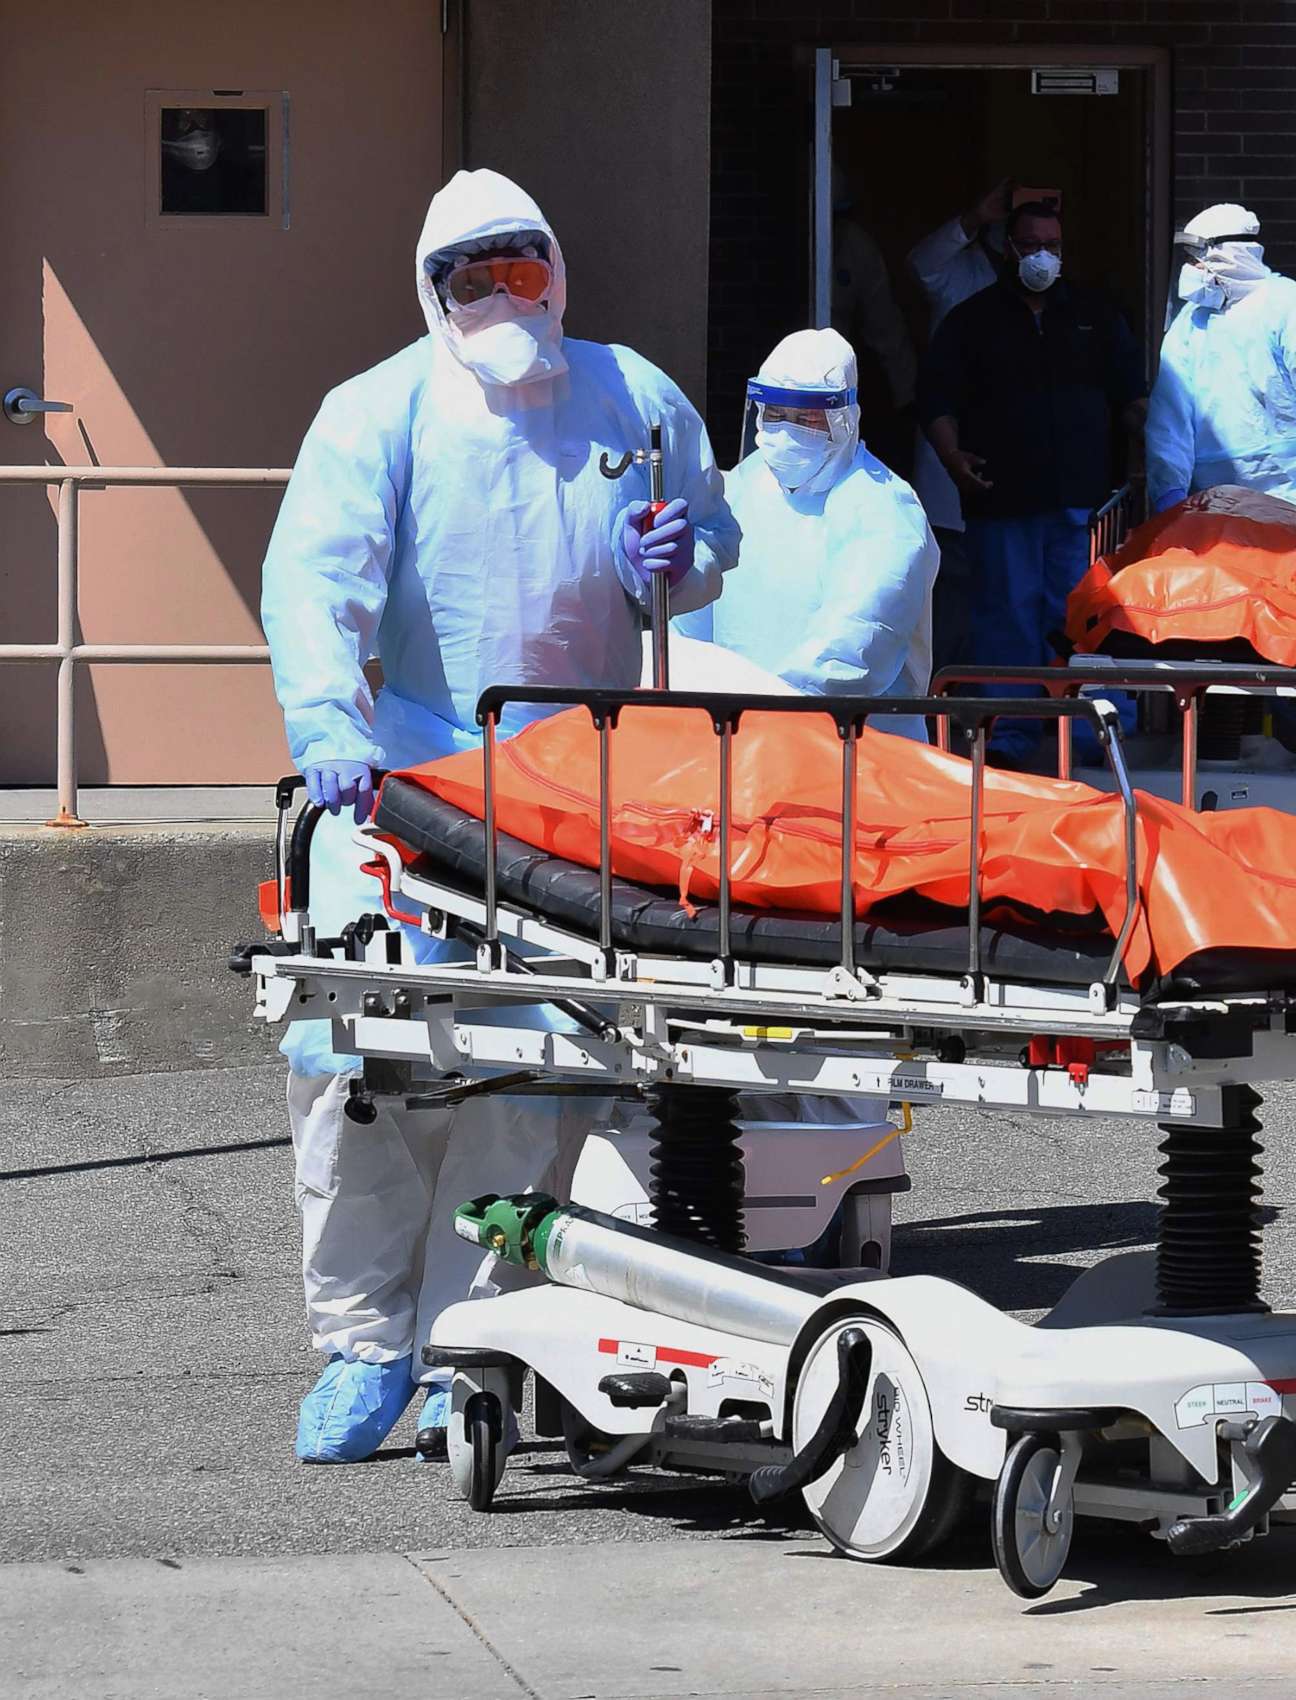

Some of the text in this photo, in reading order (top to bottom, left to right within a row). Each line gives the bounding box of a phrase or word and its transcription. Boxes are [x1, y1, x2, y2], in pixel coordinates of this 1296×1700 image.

[964, 1392, 993, 1413] str
[1252, 1396, 1272, 1404] BRAKE
[876, 1393, 892, 1475] stryker
[895, 1416, 905, 1476] WHEEL
